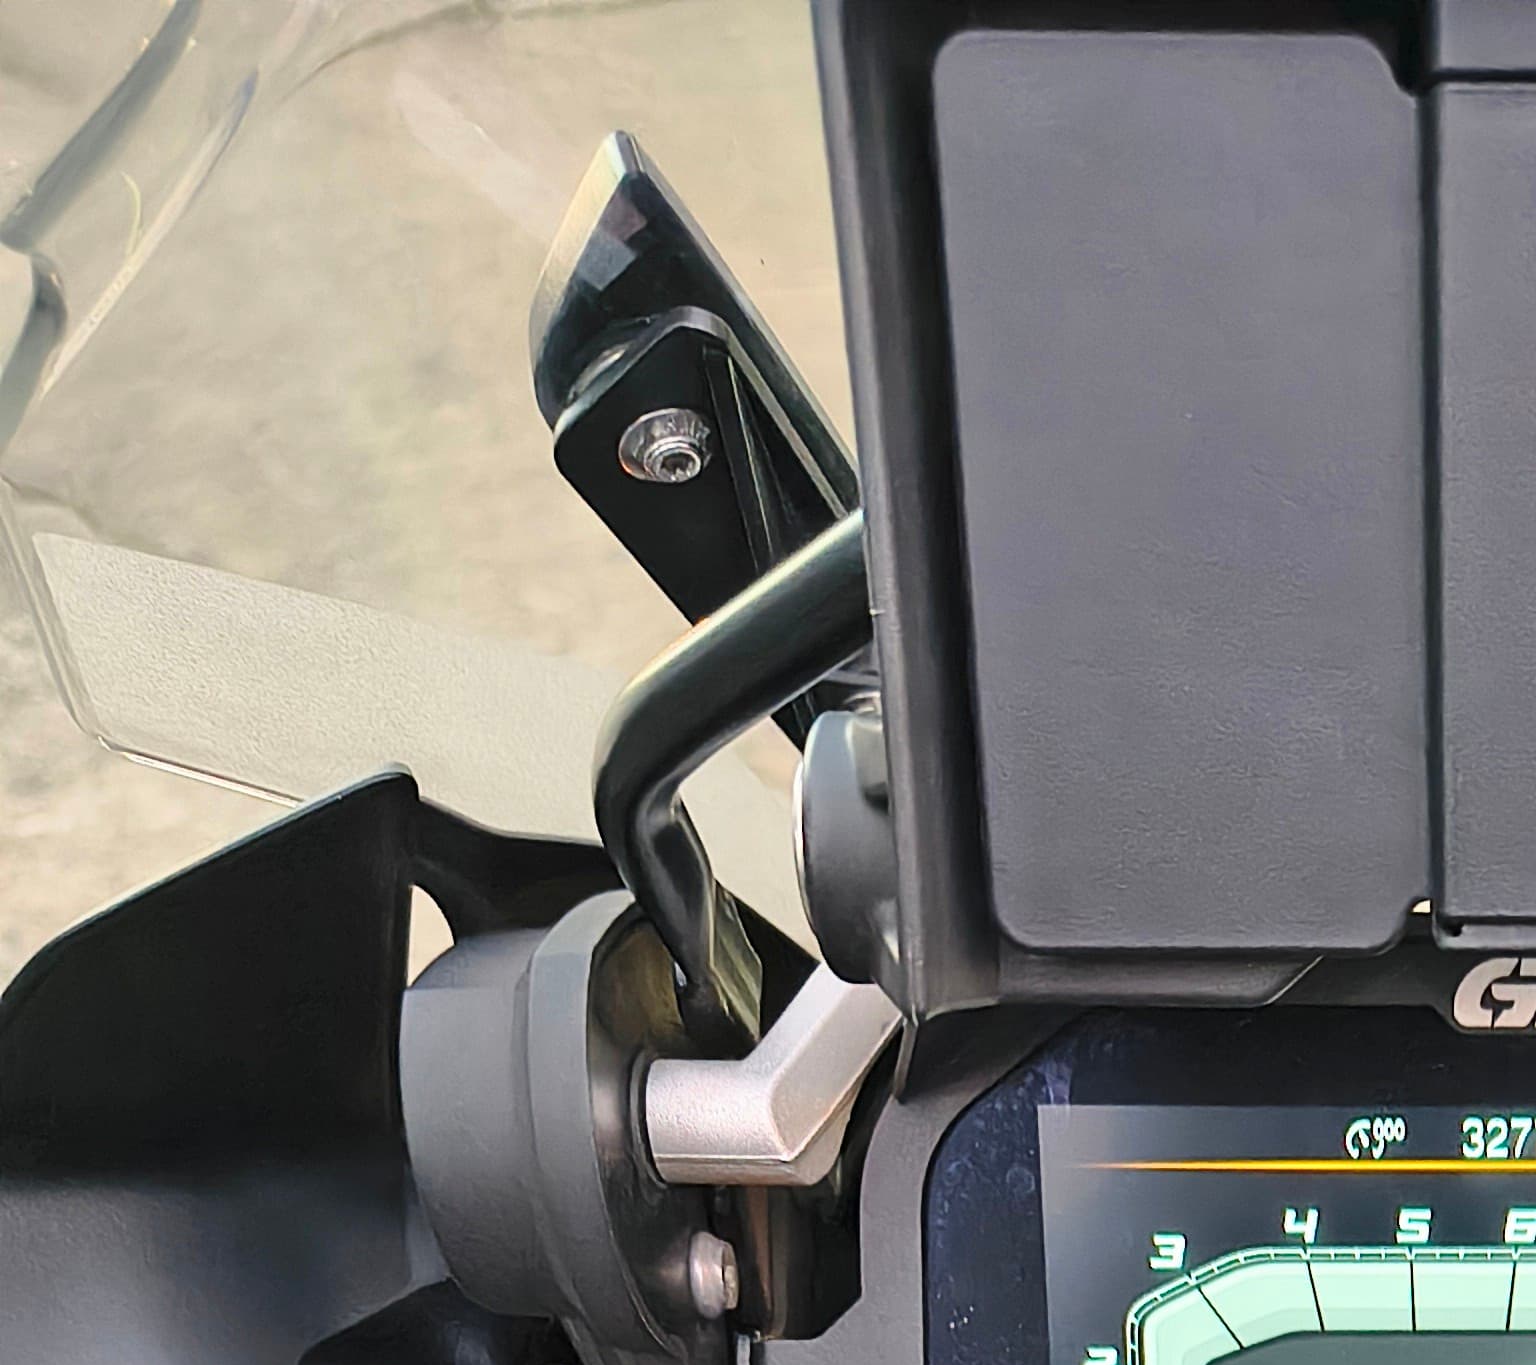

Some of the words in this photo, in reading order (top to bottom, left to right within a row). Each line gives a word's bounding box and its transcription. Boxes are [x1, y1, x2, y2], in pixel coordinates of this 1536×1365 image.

[1283, 1208, 1319, 1242] 4
[1396, 1208, 1432, 1243] 5
[1149, 1233, 1186, 1270] 3
